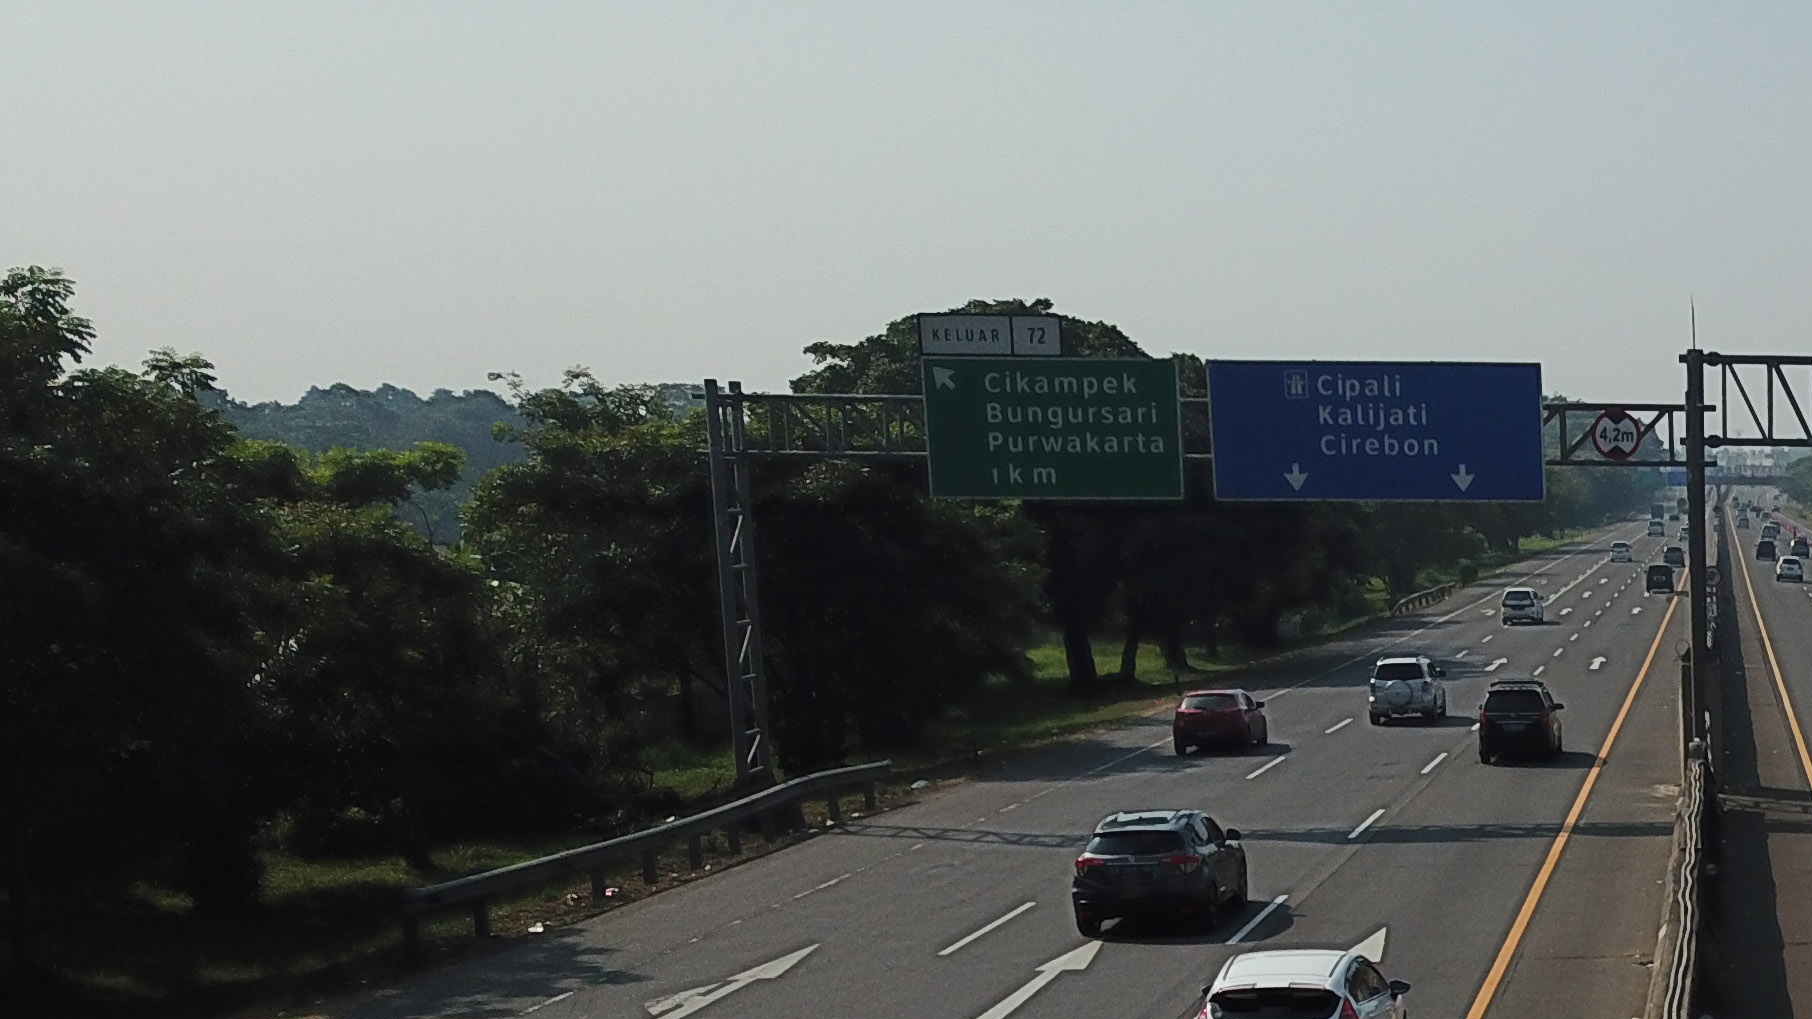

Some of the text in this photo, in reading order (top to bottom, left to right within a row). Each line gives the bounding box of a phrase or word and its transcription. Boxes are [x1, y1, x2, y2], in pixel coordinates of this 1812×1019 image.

[932, 328, 1000, 343] KELUAR
[1026, 327, 1047, 344] 72
[984, 371, 1138, 399] Cikampek
[1316, 374, 1401, 400] Cipali
[986, 402, 1158, 429] Bungursari
[1318, 403, 1427, 430] Kalijati
[988, 432, 1165, 453] Purwakarta
[1320, 433, 1439, 456] Cirebon
